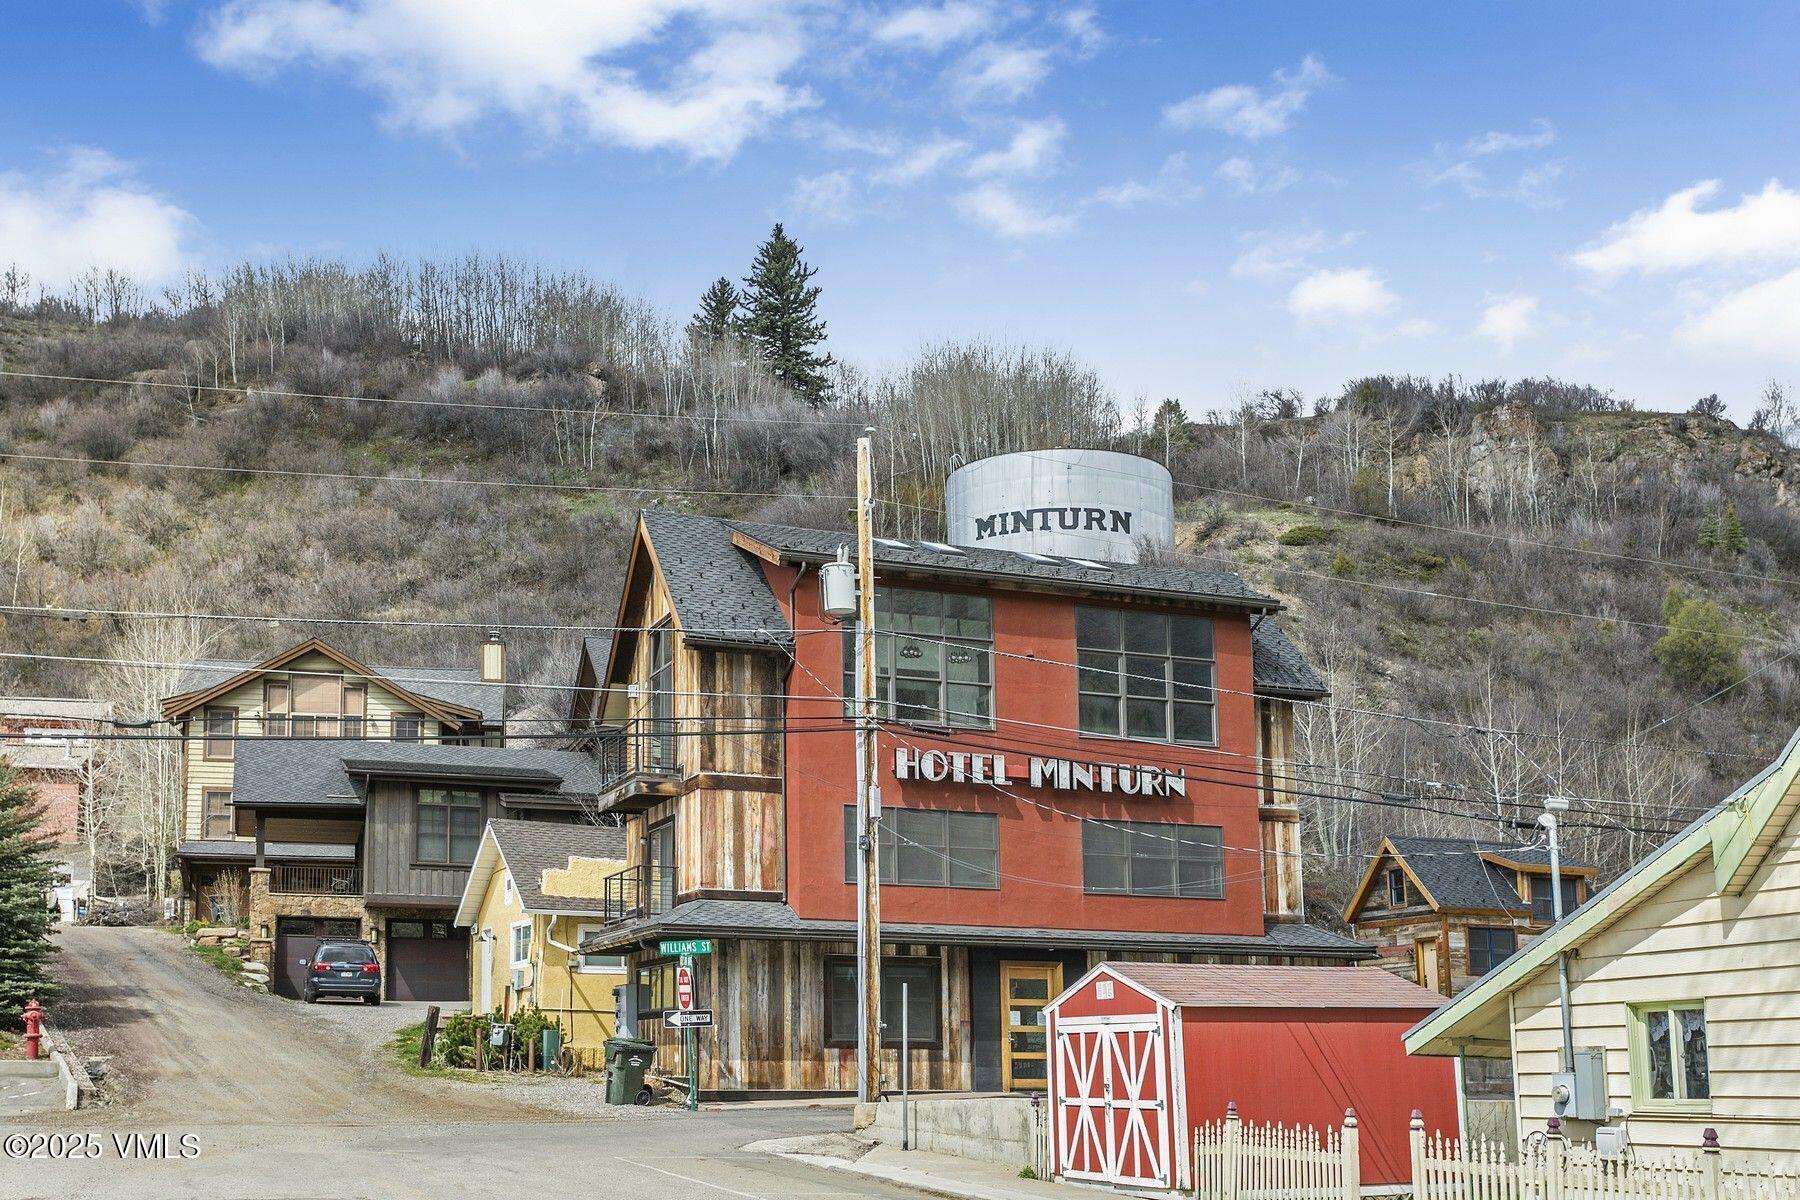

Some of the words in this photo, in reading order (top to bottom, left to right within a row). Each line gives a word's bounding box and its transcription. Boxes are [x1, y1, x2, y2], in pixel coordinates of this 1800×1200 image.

[975, 507, 1132, 541] MINTURN
[895, 747, 1012, 786] HOTEL
[1029, 757, 1186, 797] MINTURN
[660, 942, 697, 953] WILLIAMS
[701, 941, 711, 952] ST
[680, 1015, 692, 1023] ONE
[696, 1014, 708, 1022] WAY
